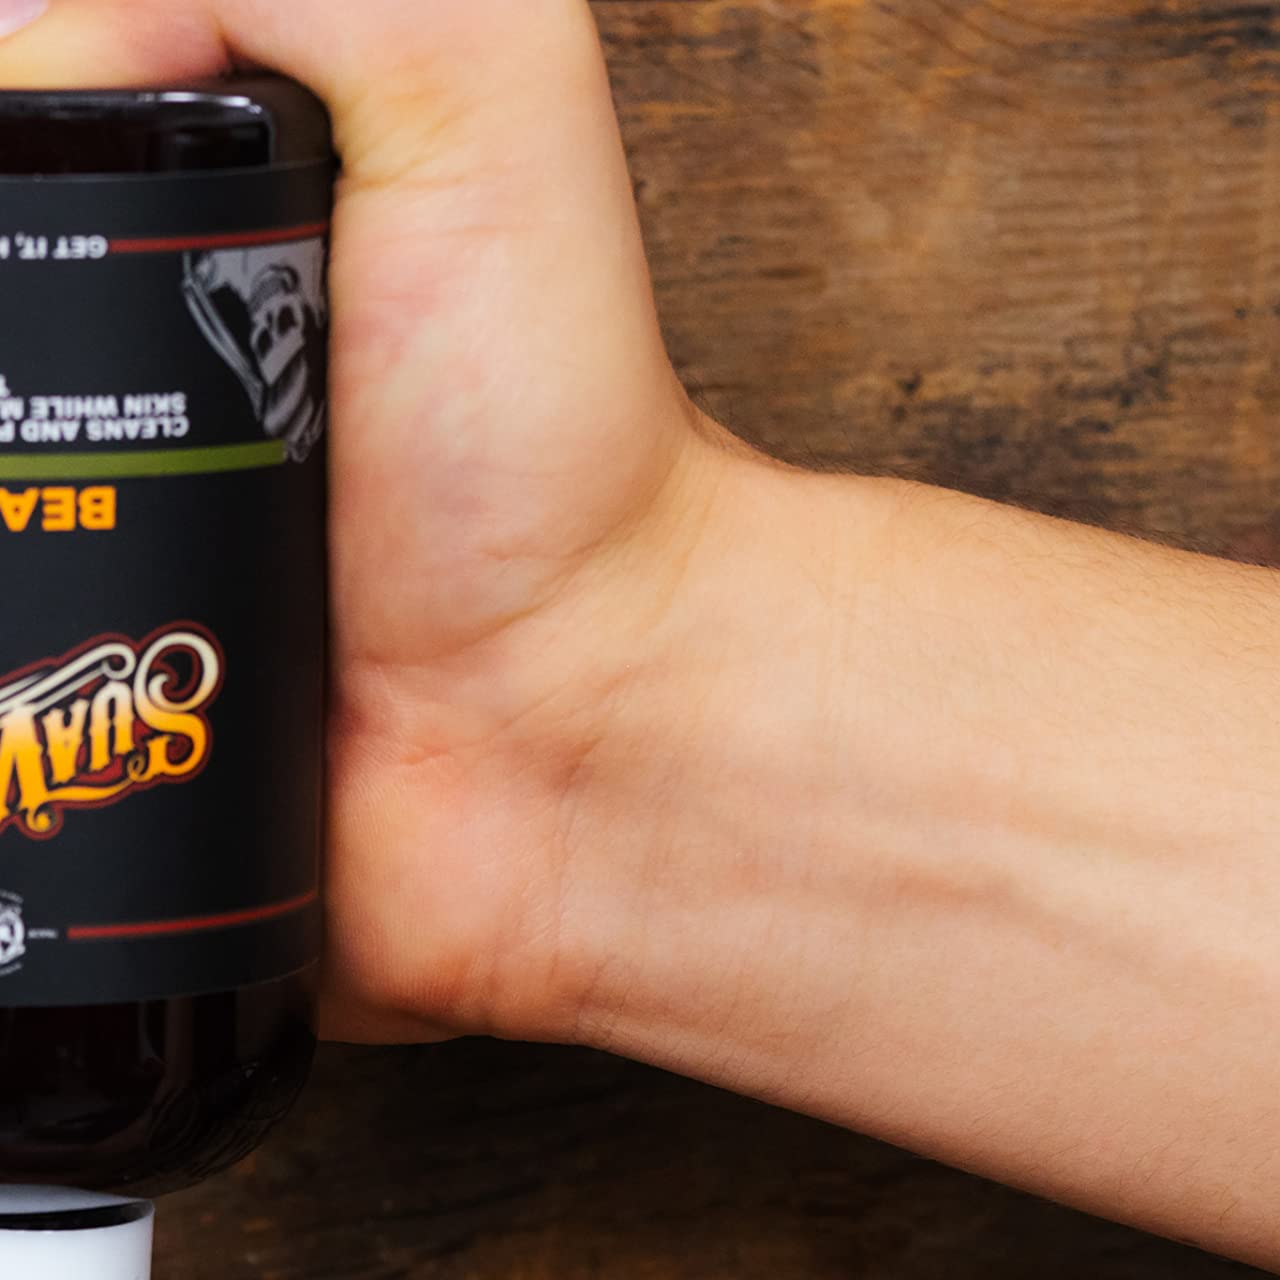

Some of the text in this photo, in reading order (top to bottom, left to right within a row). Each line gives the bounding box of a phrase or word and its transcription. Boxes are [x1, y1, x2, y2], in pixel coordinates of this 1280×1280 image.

[15, 231, 49, 260] IT,
[53, 234, 109, 260] GET
[29, 395, 119, 419] WHILE
[123, 391, 186, 418] SKIN
[20, 418, 80, 442] AND
[86, 415, 190, 442] CLEANS
